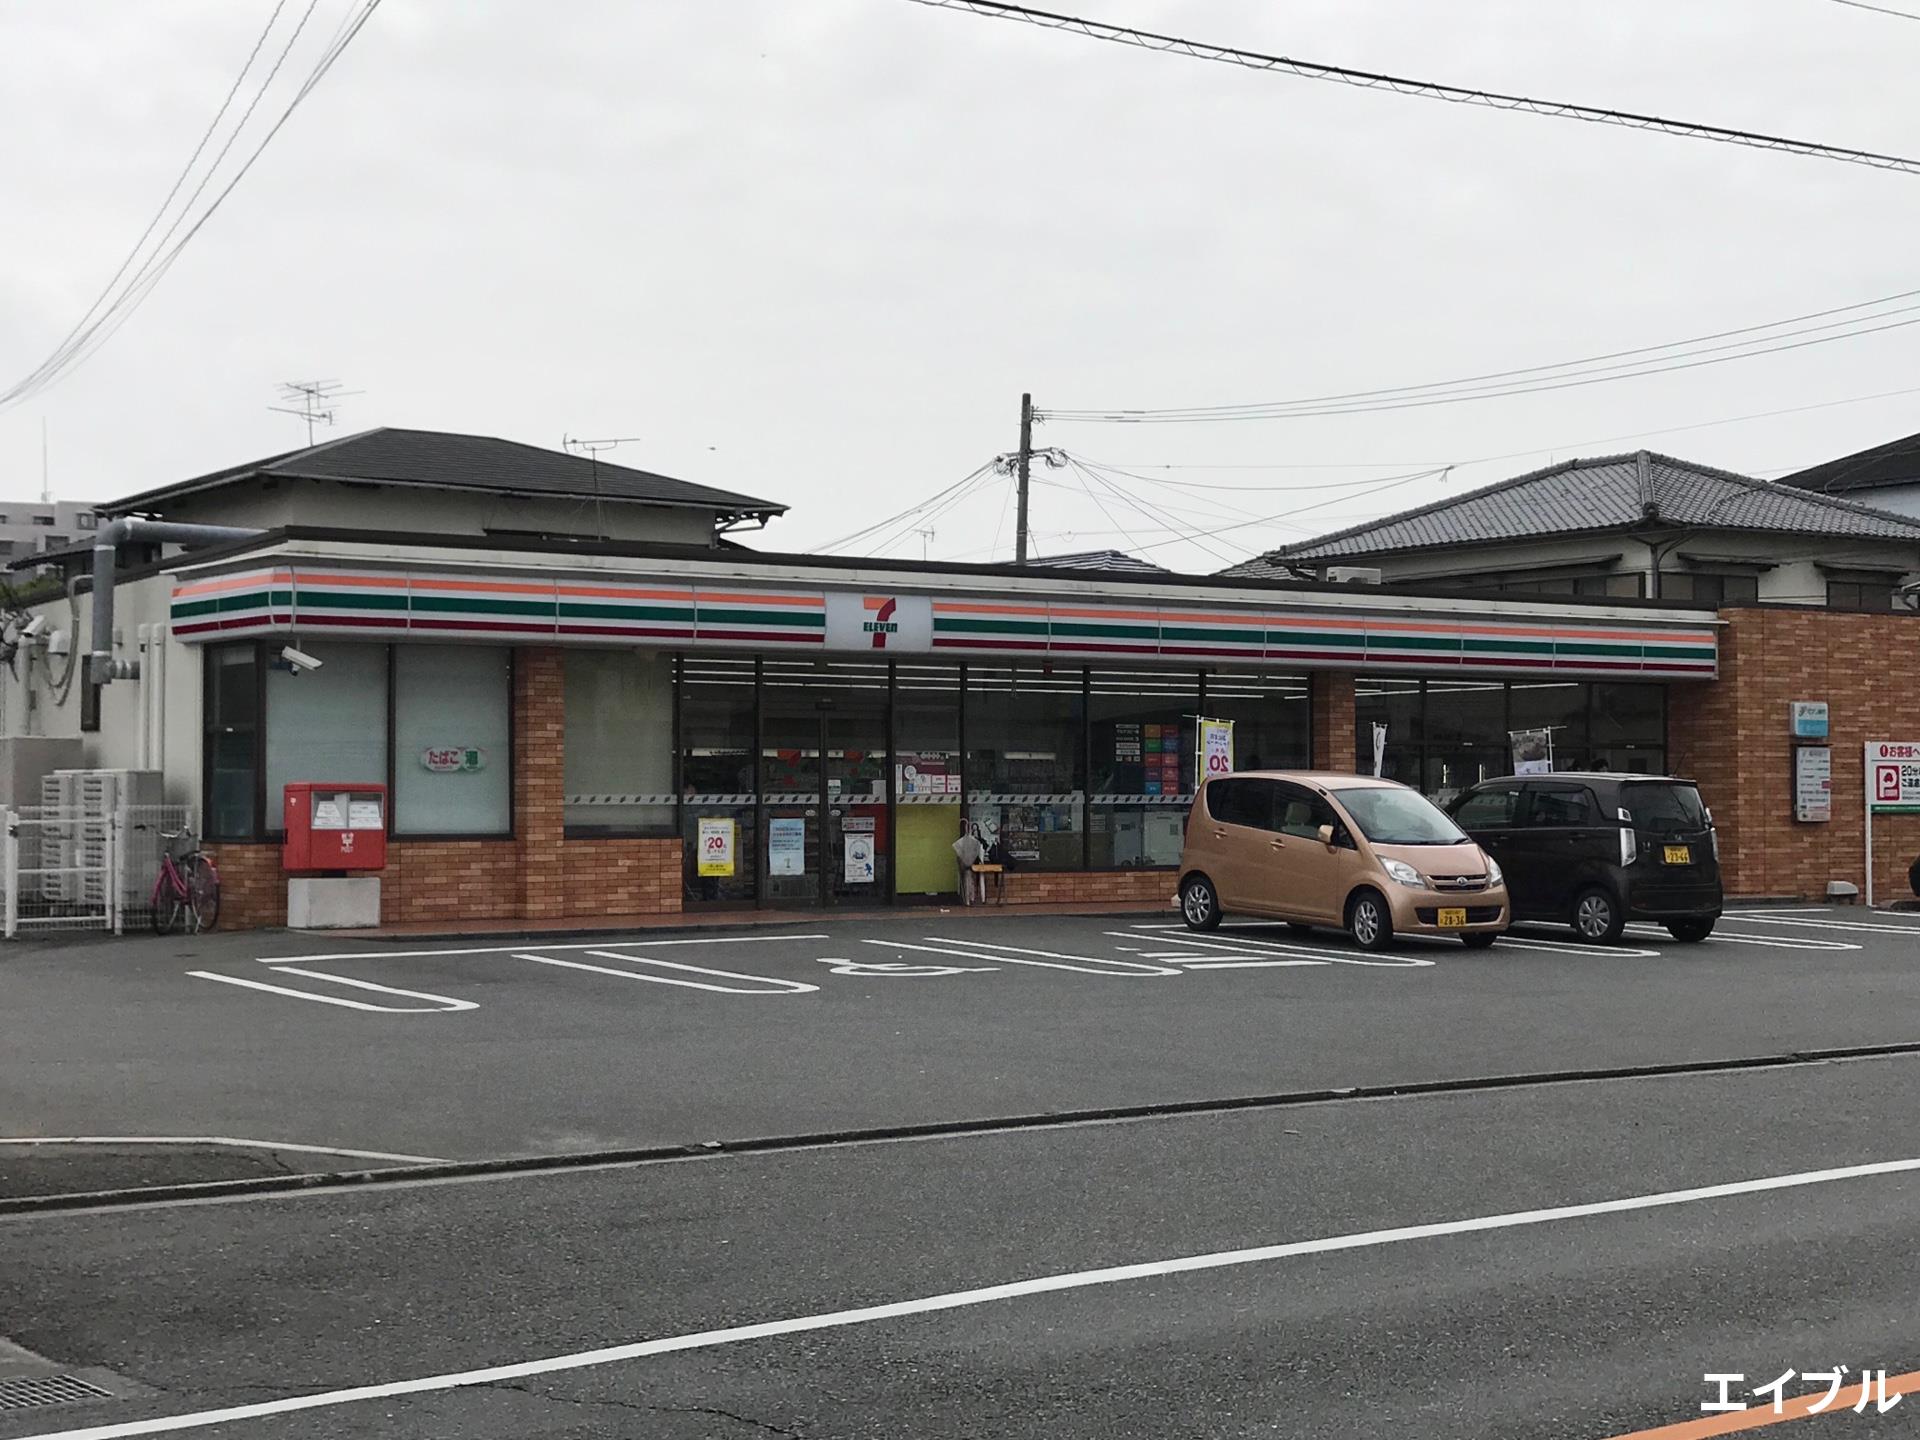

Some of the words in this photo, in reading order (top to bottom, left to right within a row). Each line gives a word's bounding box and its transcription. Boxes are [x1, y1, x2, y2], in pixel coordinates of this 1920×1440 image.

[429, 751, 460, 764] たばこ
[1889, 746, 1920, 757] お客様へ
[1901, 765, 1920, 777] 20分
[707, 837, 723, 849] 20
